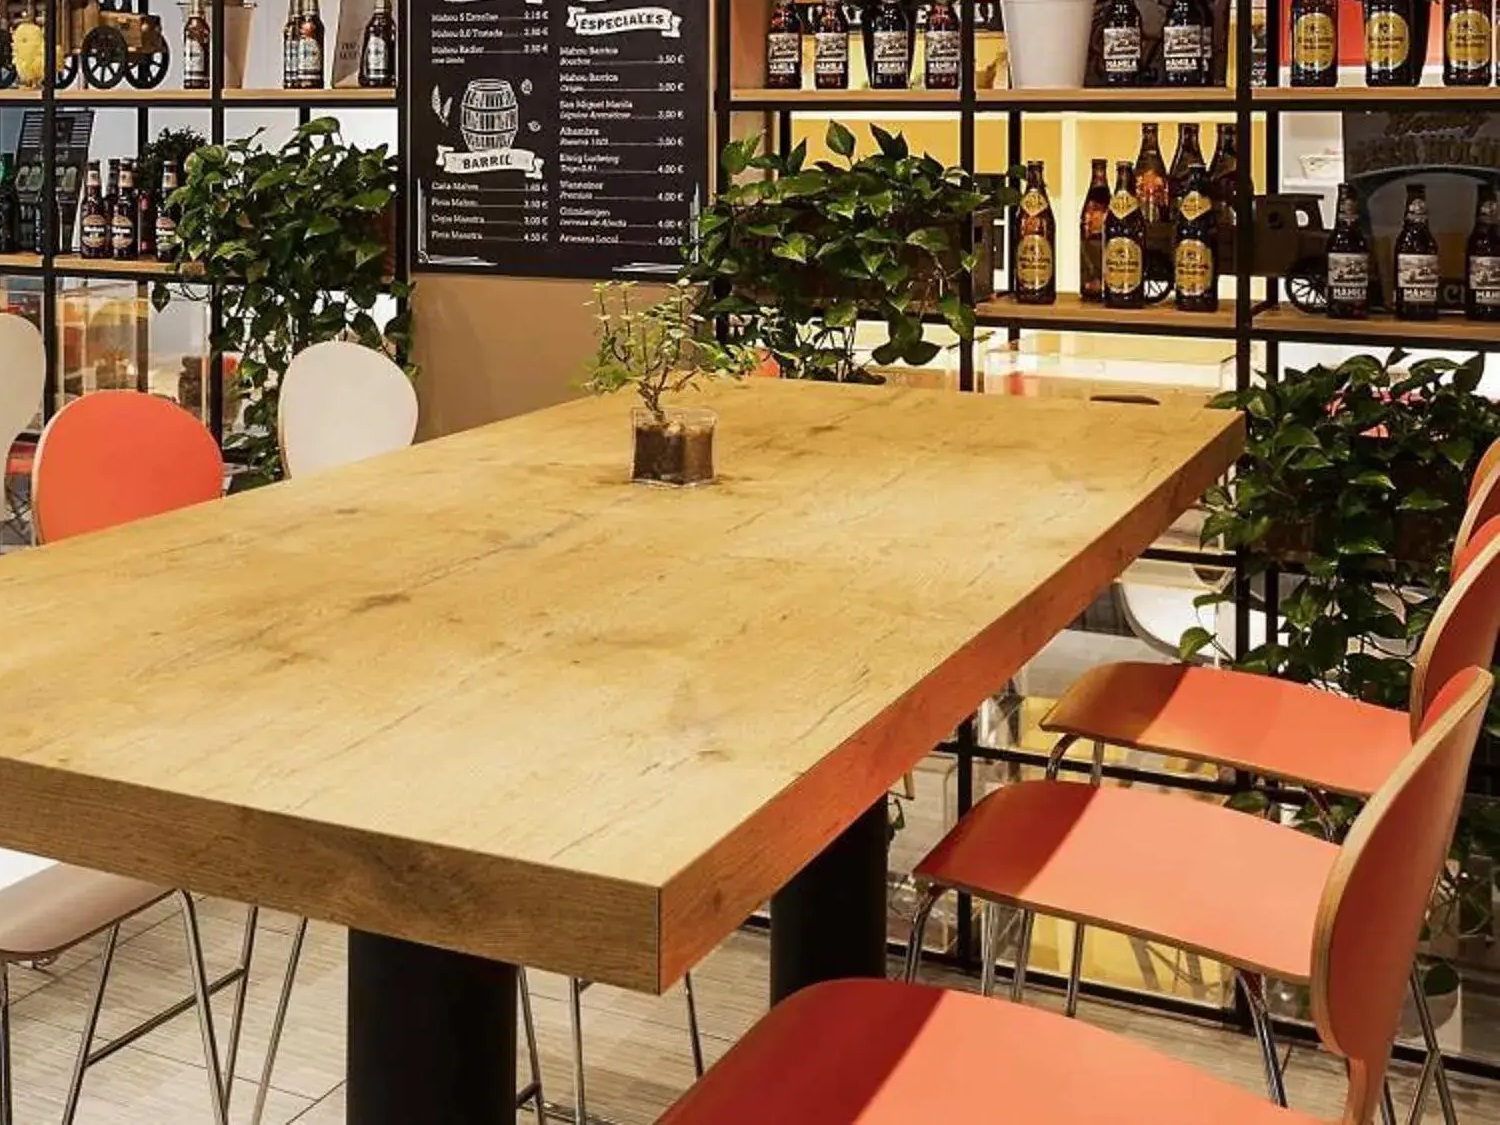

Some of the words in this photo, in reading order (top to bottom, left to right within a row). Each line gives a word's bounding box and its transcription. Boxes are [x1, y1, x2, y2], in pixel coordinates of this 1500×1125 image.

[578, 15, 665, 32] ESPECIALES
[560, 127, 600, 136] Alhambra
[462, 154, 513, 170] BARRIL
